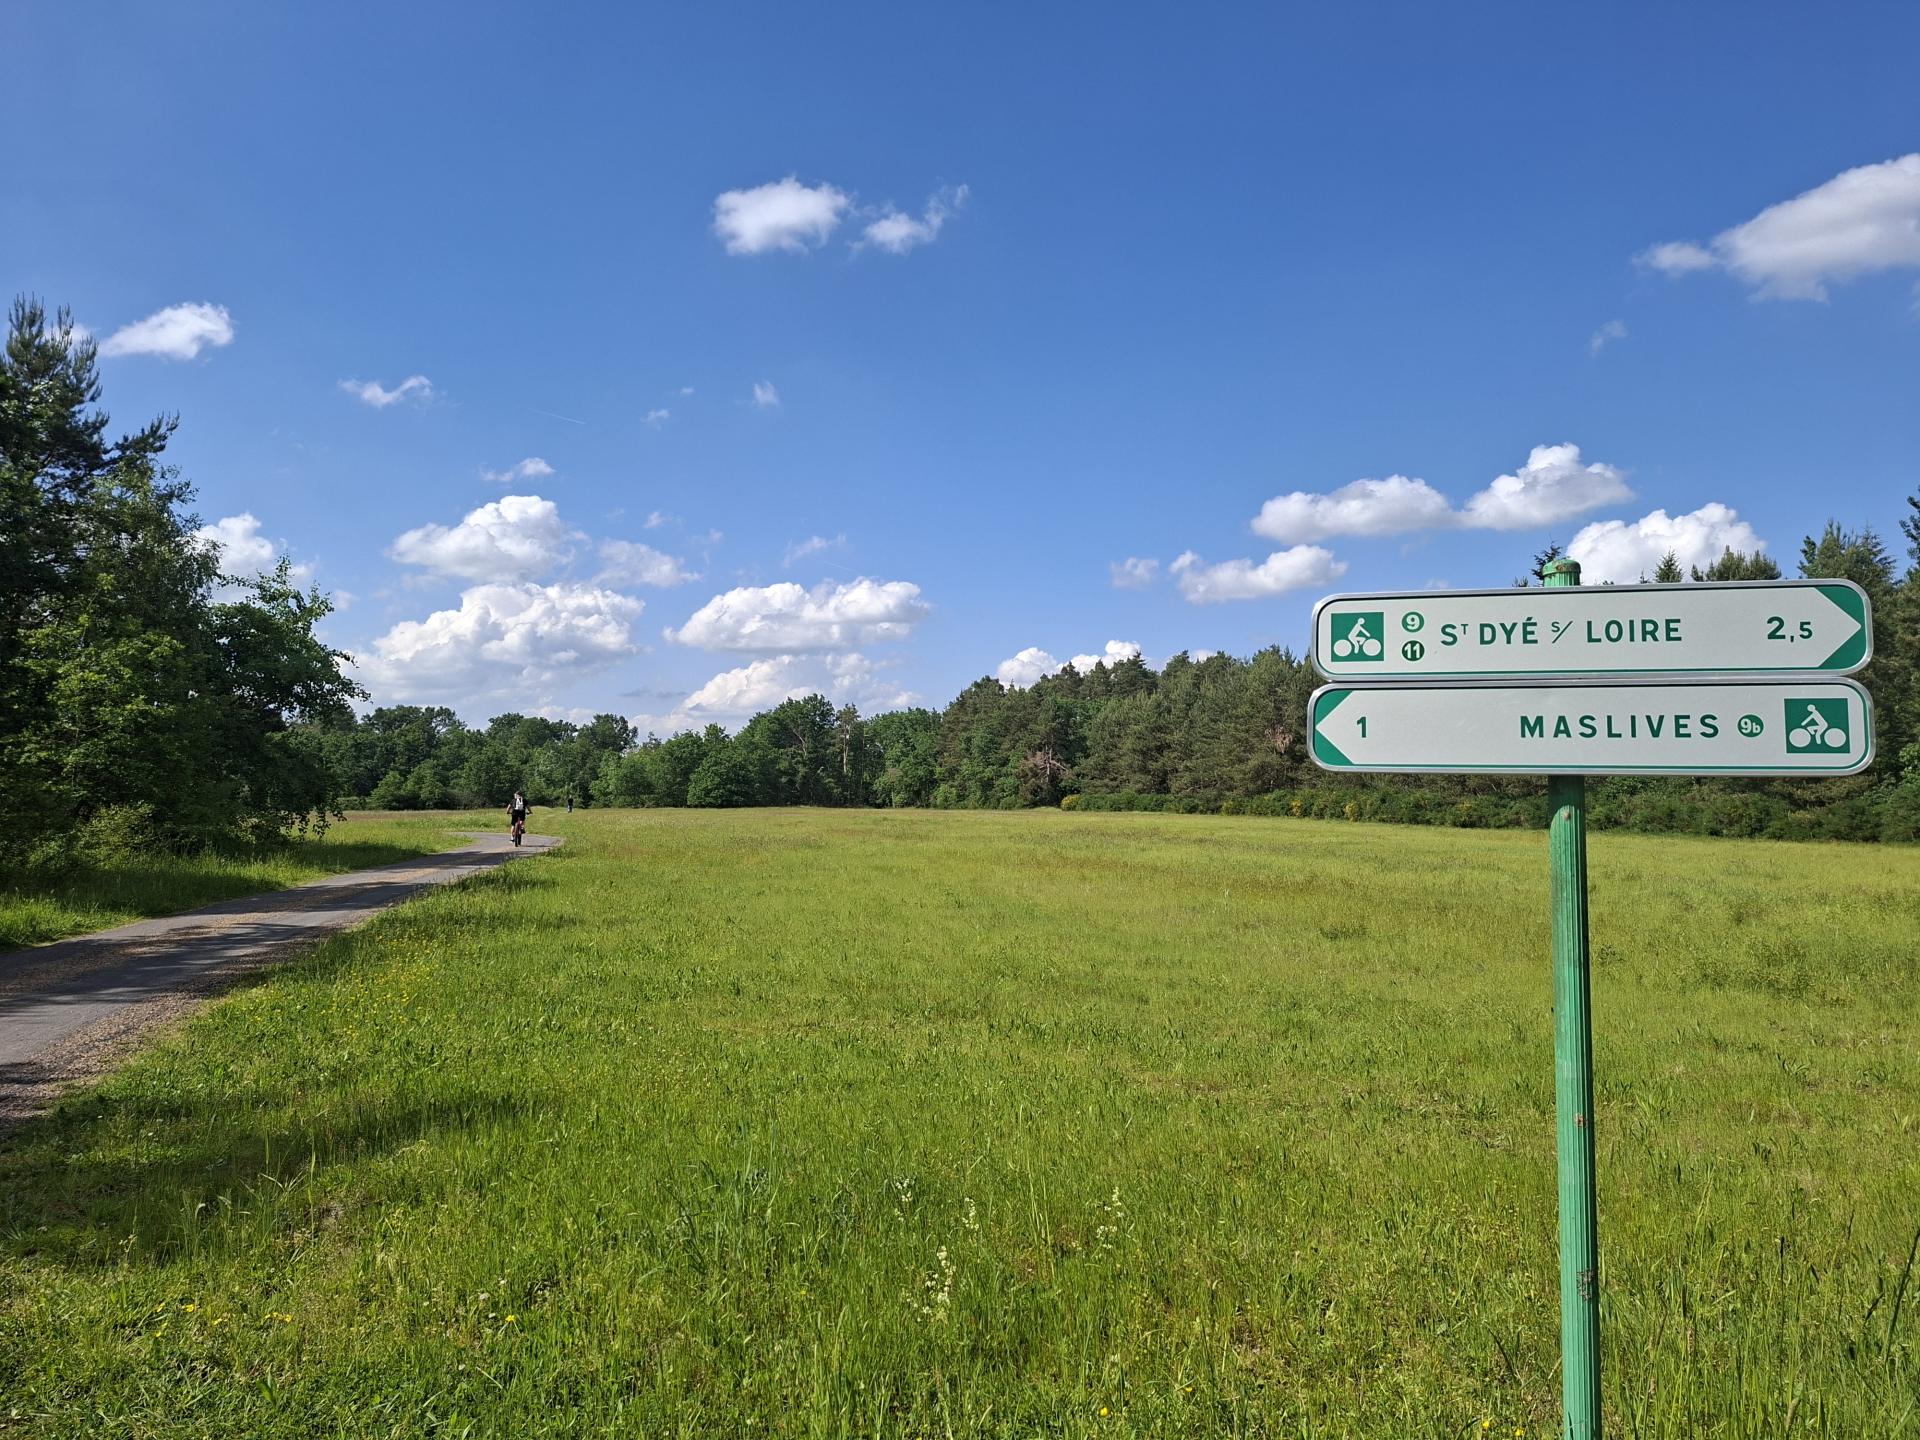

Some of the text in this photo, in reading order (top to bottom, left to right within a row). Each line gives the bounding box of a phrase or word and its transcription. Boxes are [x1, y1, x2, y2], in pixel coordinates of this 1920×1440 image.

[1405, 613, 1421, 631] 9
[1479, 616, 1539, 645] DYÉ
[1586, 618, 1683, 643] LOIRE
[1766, 616, 1813, 643] 2,5
[1403, 642, 1423, 660] 11
[1356, 716, 1368, 739] 1
[1520, 714, 1719, 739] MASLIVES
[1740, 718, 1761, 735] 9b
